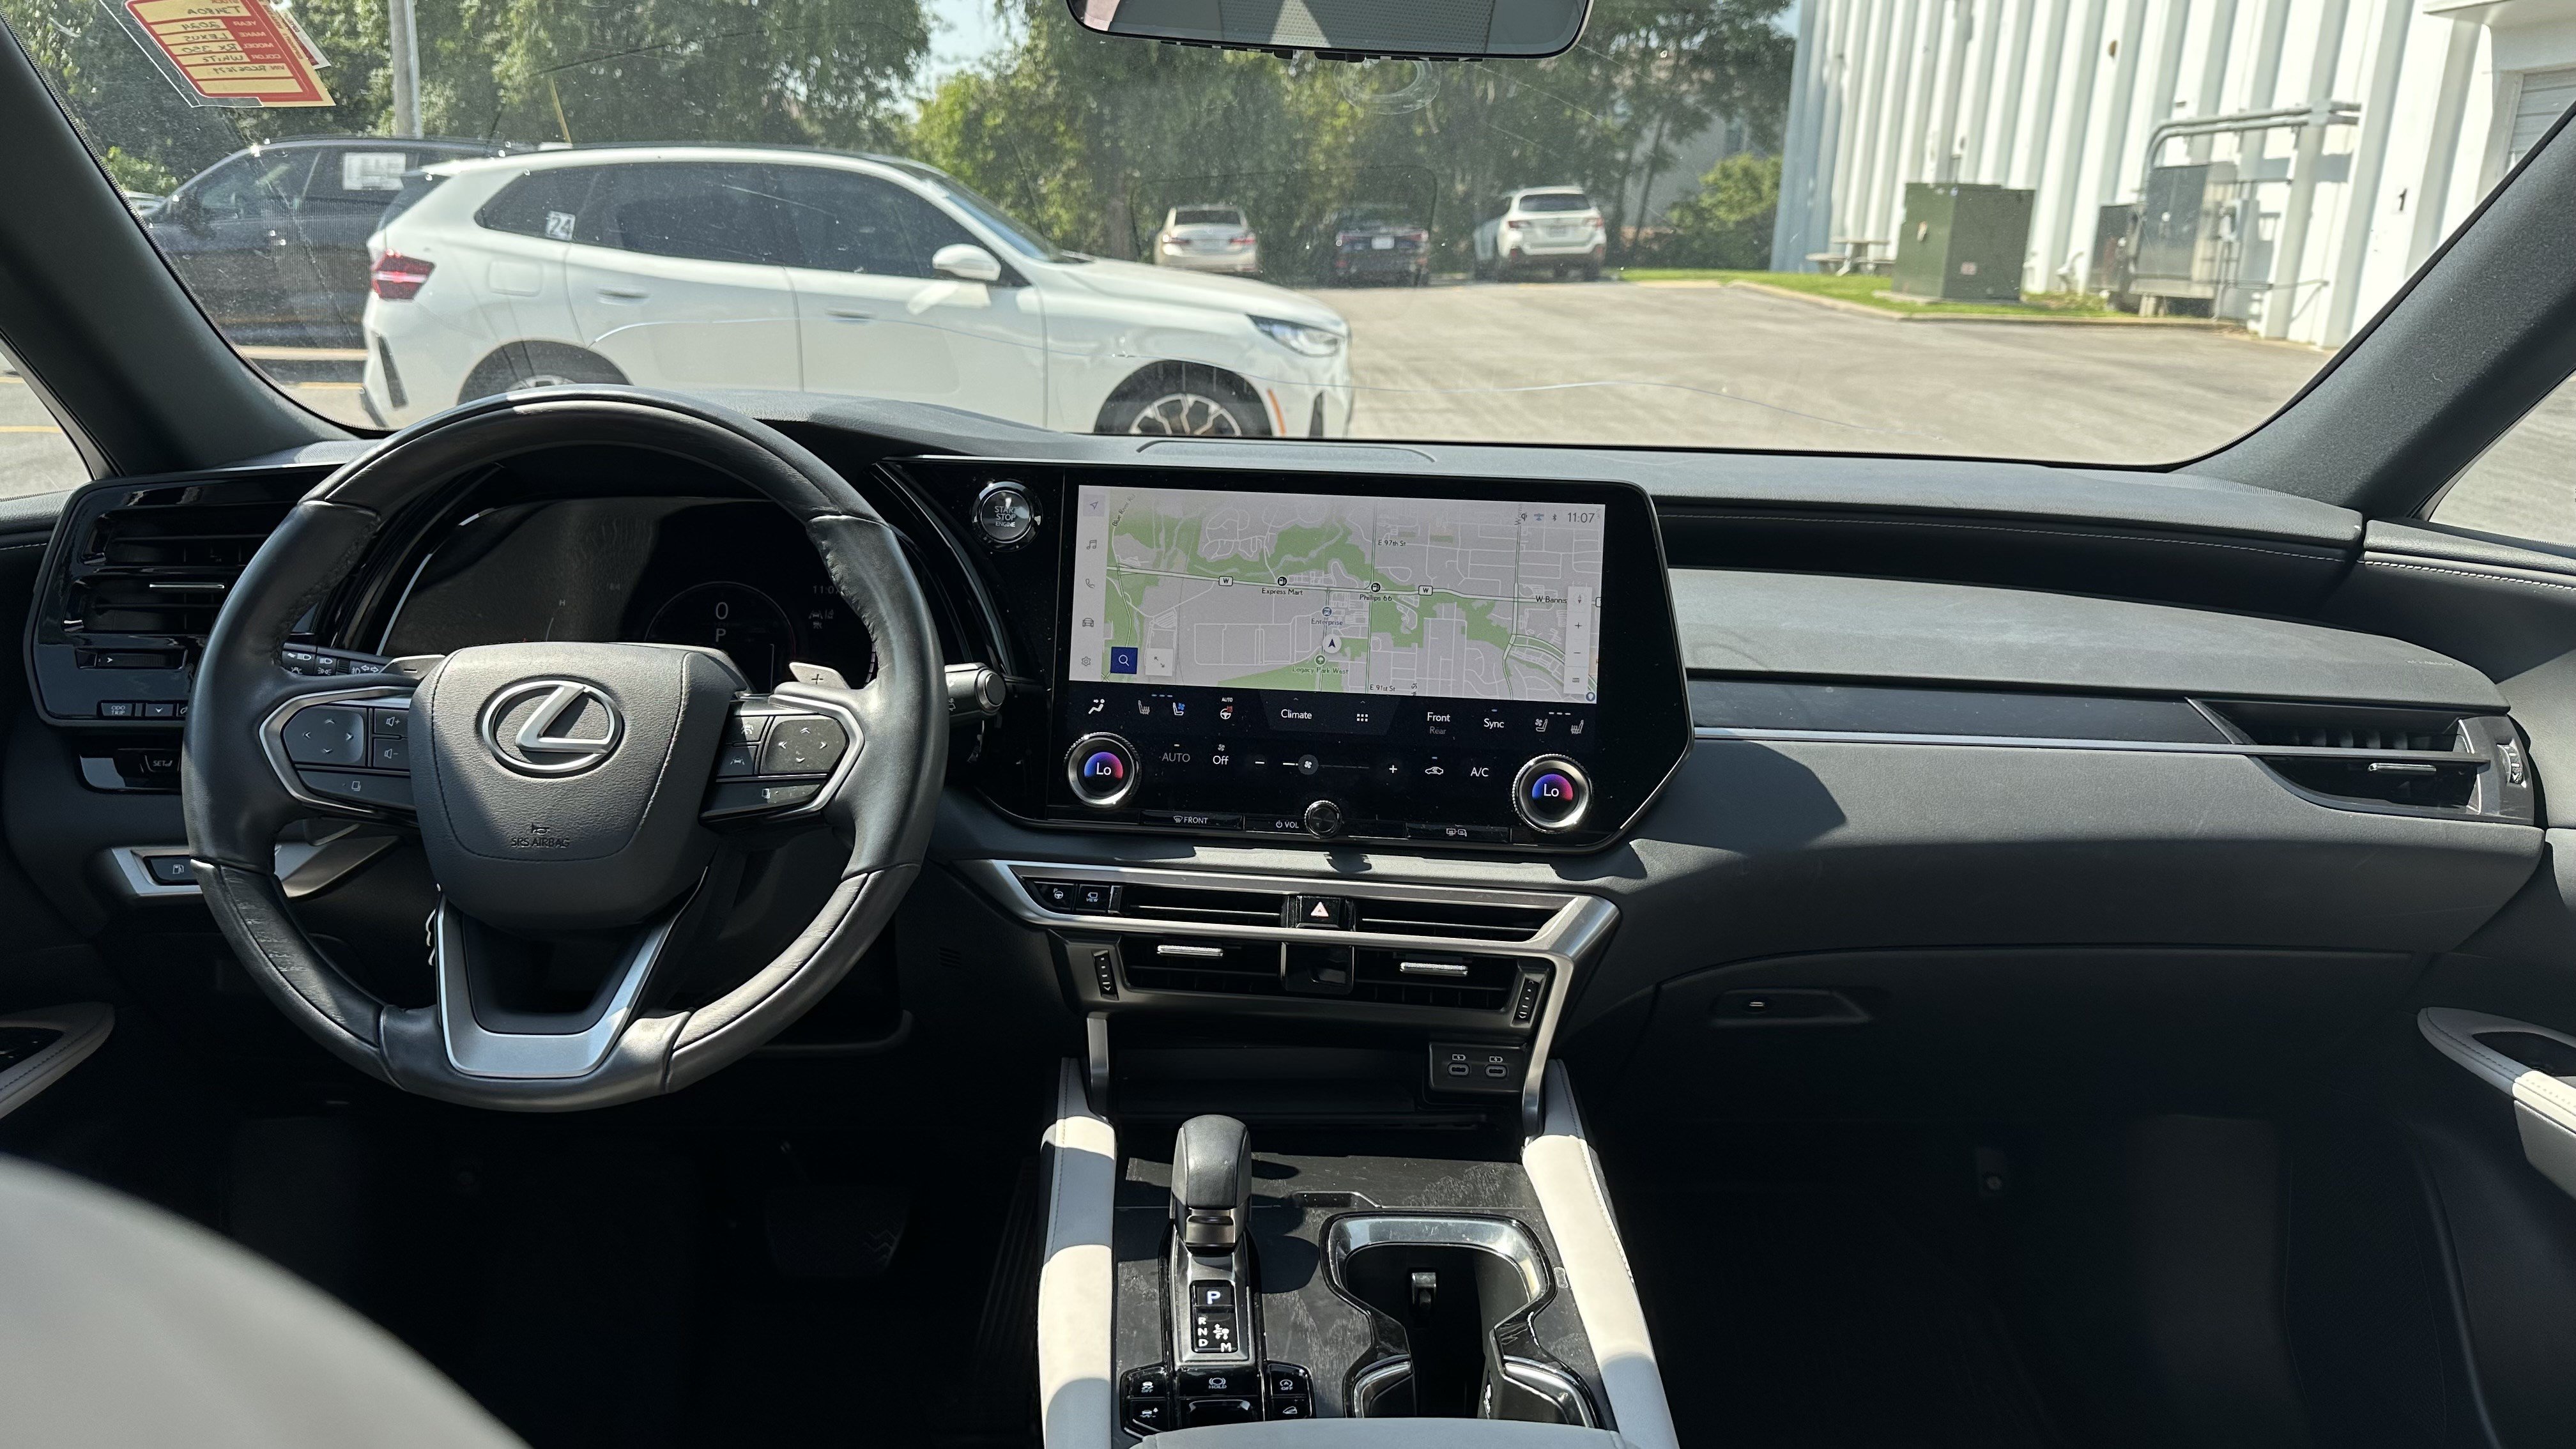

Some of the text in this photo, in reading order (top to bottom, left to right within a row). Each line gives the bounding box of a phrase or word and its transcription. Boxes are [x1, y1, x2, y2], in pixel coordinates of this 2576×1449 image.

[1568, 512, 1595, 523] 11:07
[715, 629, 726, 642] P
[1292, 666, 1314, 674] Legacy
[1280, 709, 1312, 719] Climate
[1427, 712, 1451, 722] Front
[1483, 717, 1505, 730] Sync
[1429, 726, 1447, 735] Rear
[1162, 753, 1190, 763] AUTO
[1213, 755, 1229, 765] Off
[1096, 762, 1112, 776] Lo
[1470, 767, 1489, 777] A/C
[1543, 783, 1560, 797] Lo
[510, 837, 571, 848] SRS AIRBAG
[1207, 1290, 1221, 1305] P
[1197, 1317, 1207, 1325] R
[1197, 1327, 1208, 1336] N
[1198, 1338, 1208, 1347] D
[1220, 1342, 1232, 1353] M
